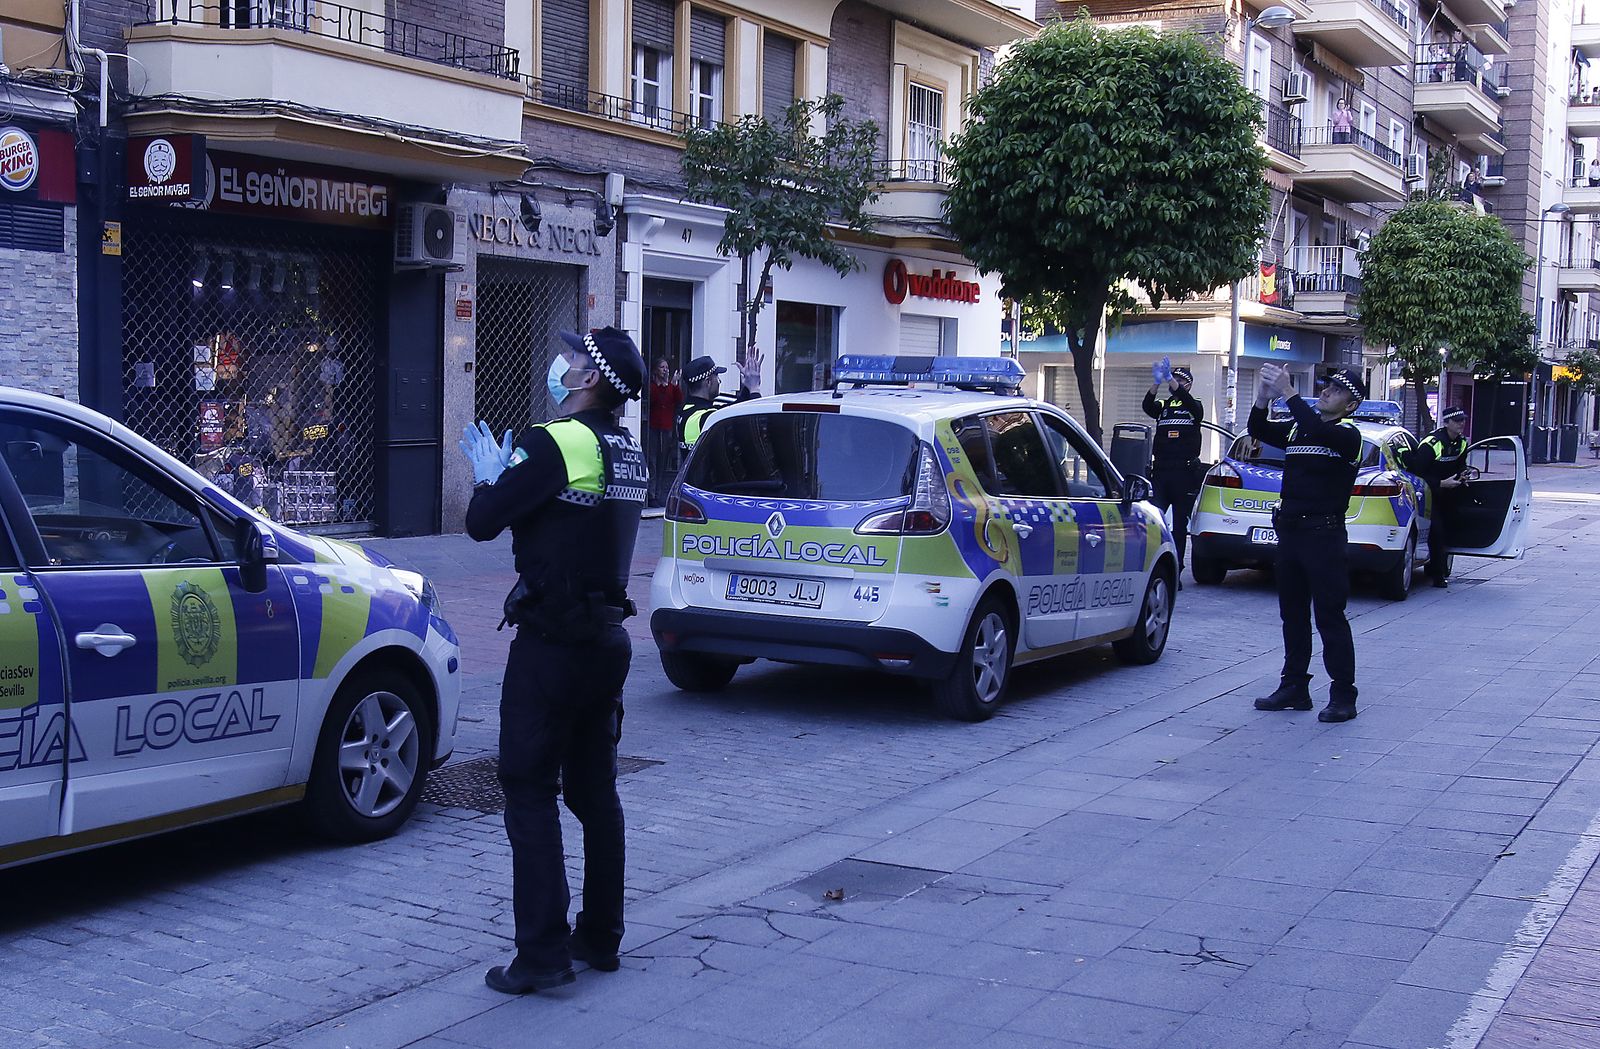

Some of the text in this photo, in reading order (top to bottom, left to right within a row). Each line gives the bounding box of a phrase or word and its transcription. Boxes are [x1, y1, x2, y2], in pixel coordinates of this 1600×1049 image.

[0, 141, 31, 160] BURGER
[1, 151, 33, 175] KING
[129, 186, 138, 198] EL
[219, 167, 243, 203] EL
[468, 213, 522, 247] NECK
[547, 223, 601, 256] NECK
[681, 228, 692, 243] 47
[908, 269, 980, 304] vodafone
[682, 534, 887, 567] POLICÍA LOCAL
[739, 578, 777, 597] 9003
[788, 582, 820, 601] JLJ
[853, 586, 880, 603] 445
[1027, 575, 1135, 615] POLICÍA LOCAL
[167, 676, 226, 690] policia.sevilla.org
[113, 687, 281, 756] LOCAL
